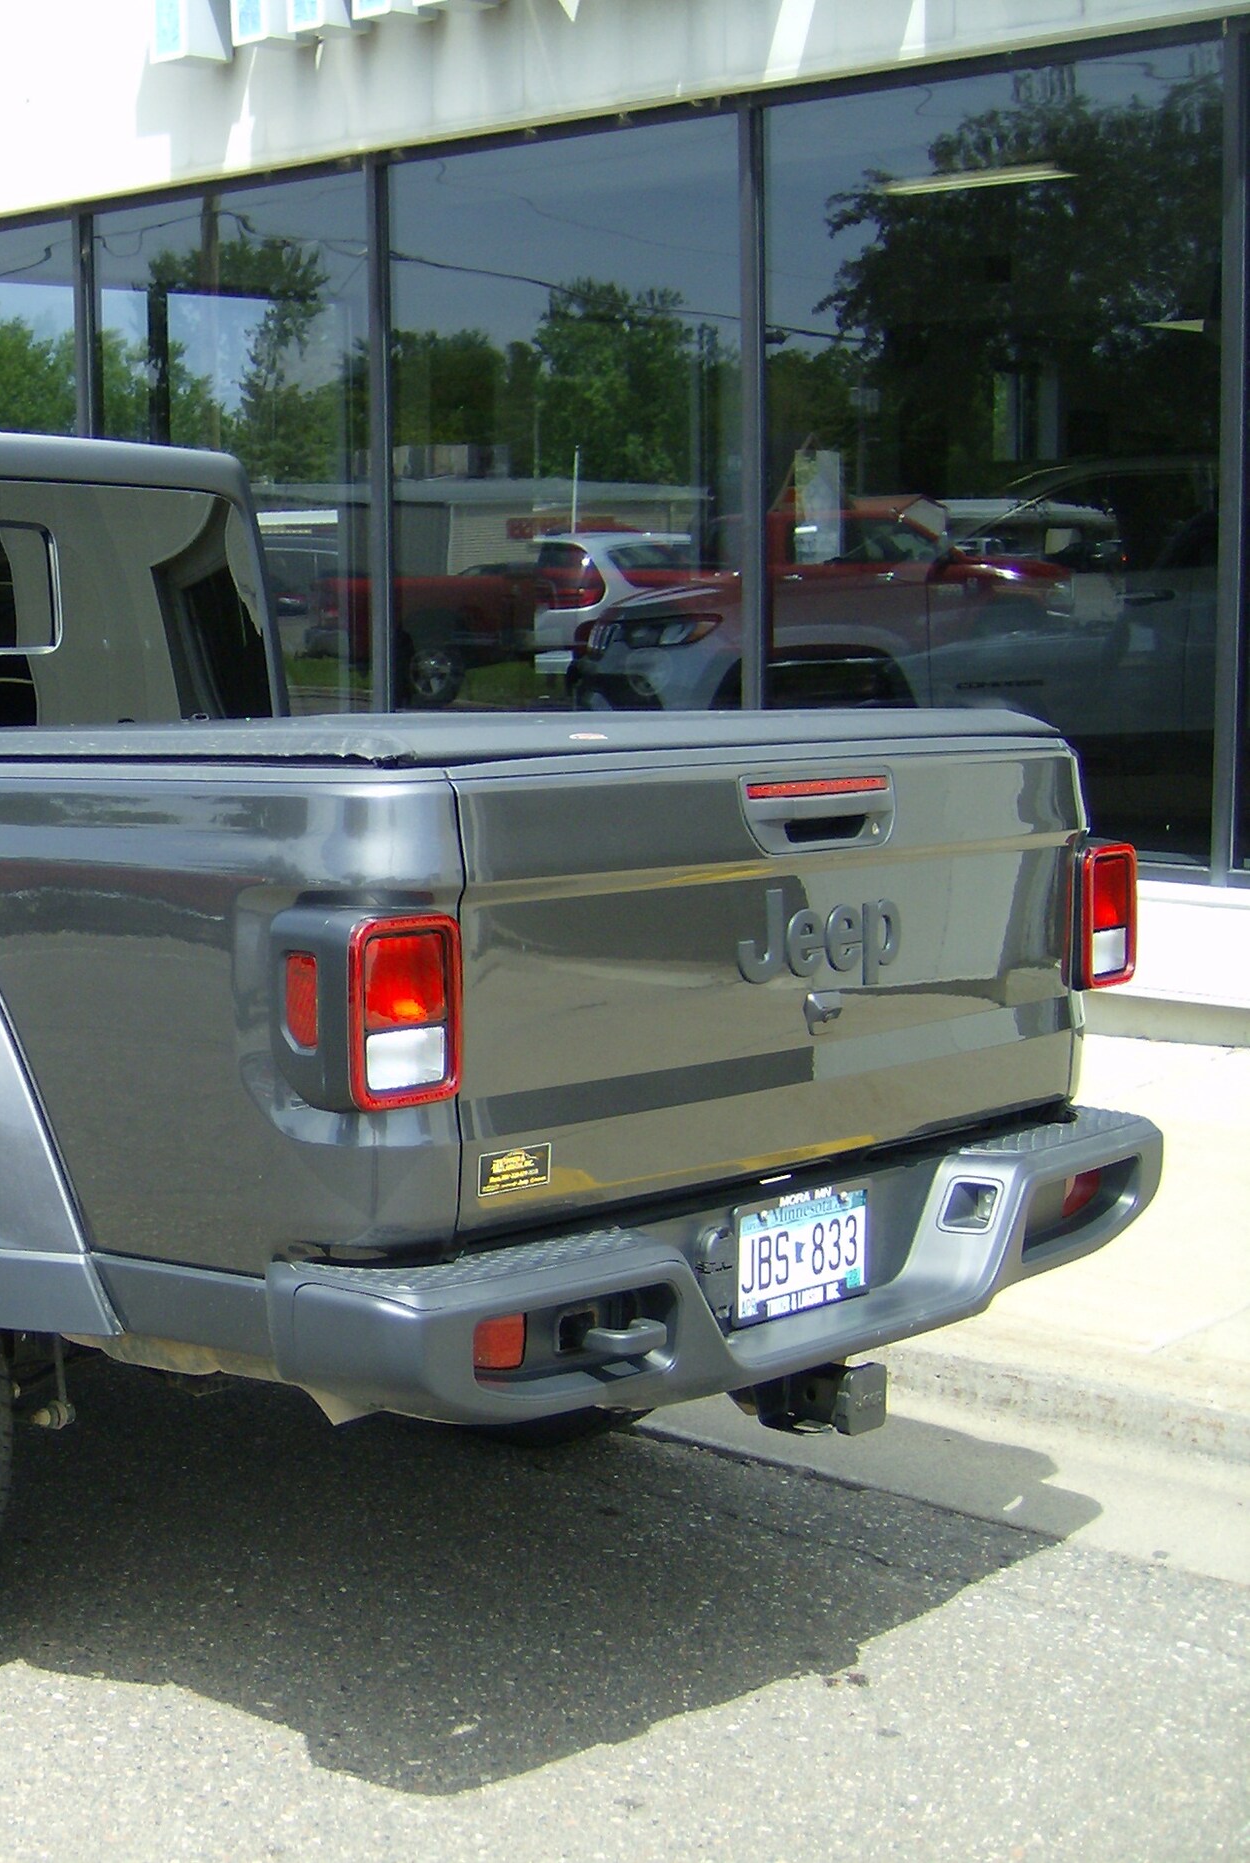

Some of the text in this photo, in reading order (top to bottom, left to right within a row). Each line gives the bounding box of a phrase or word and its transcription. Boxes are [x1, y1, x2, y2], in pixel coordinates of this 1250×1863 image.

[738, 889, 901, 985] Jeep
[772, 1199, 832, 1223] Minnesota
[779, 1186, 833, 1207] MORA MN
[741, 1215, 857, 1294] JBS 833
